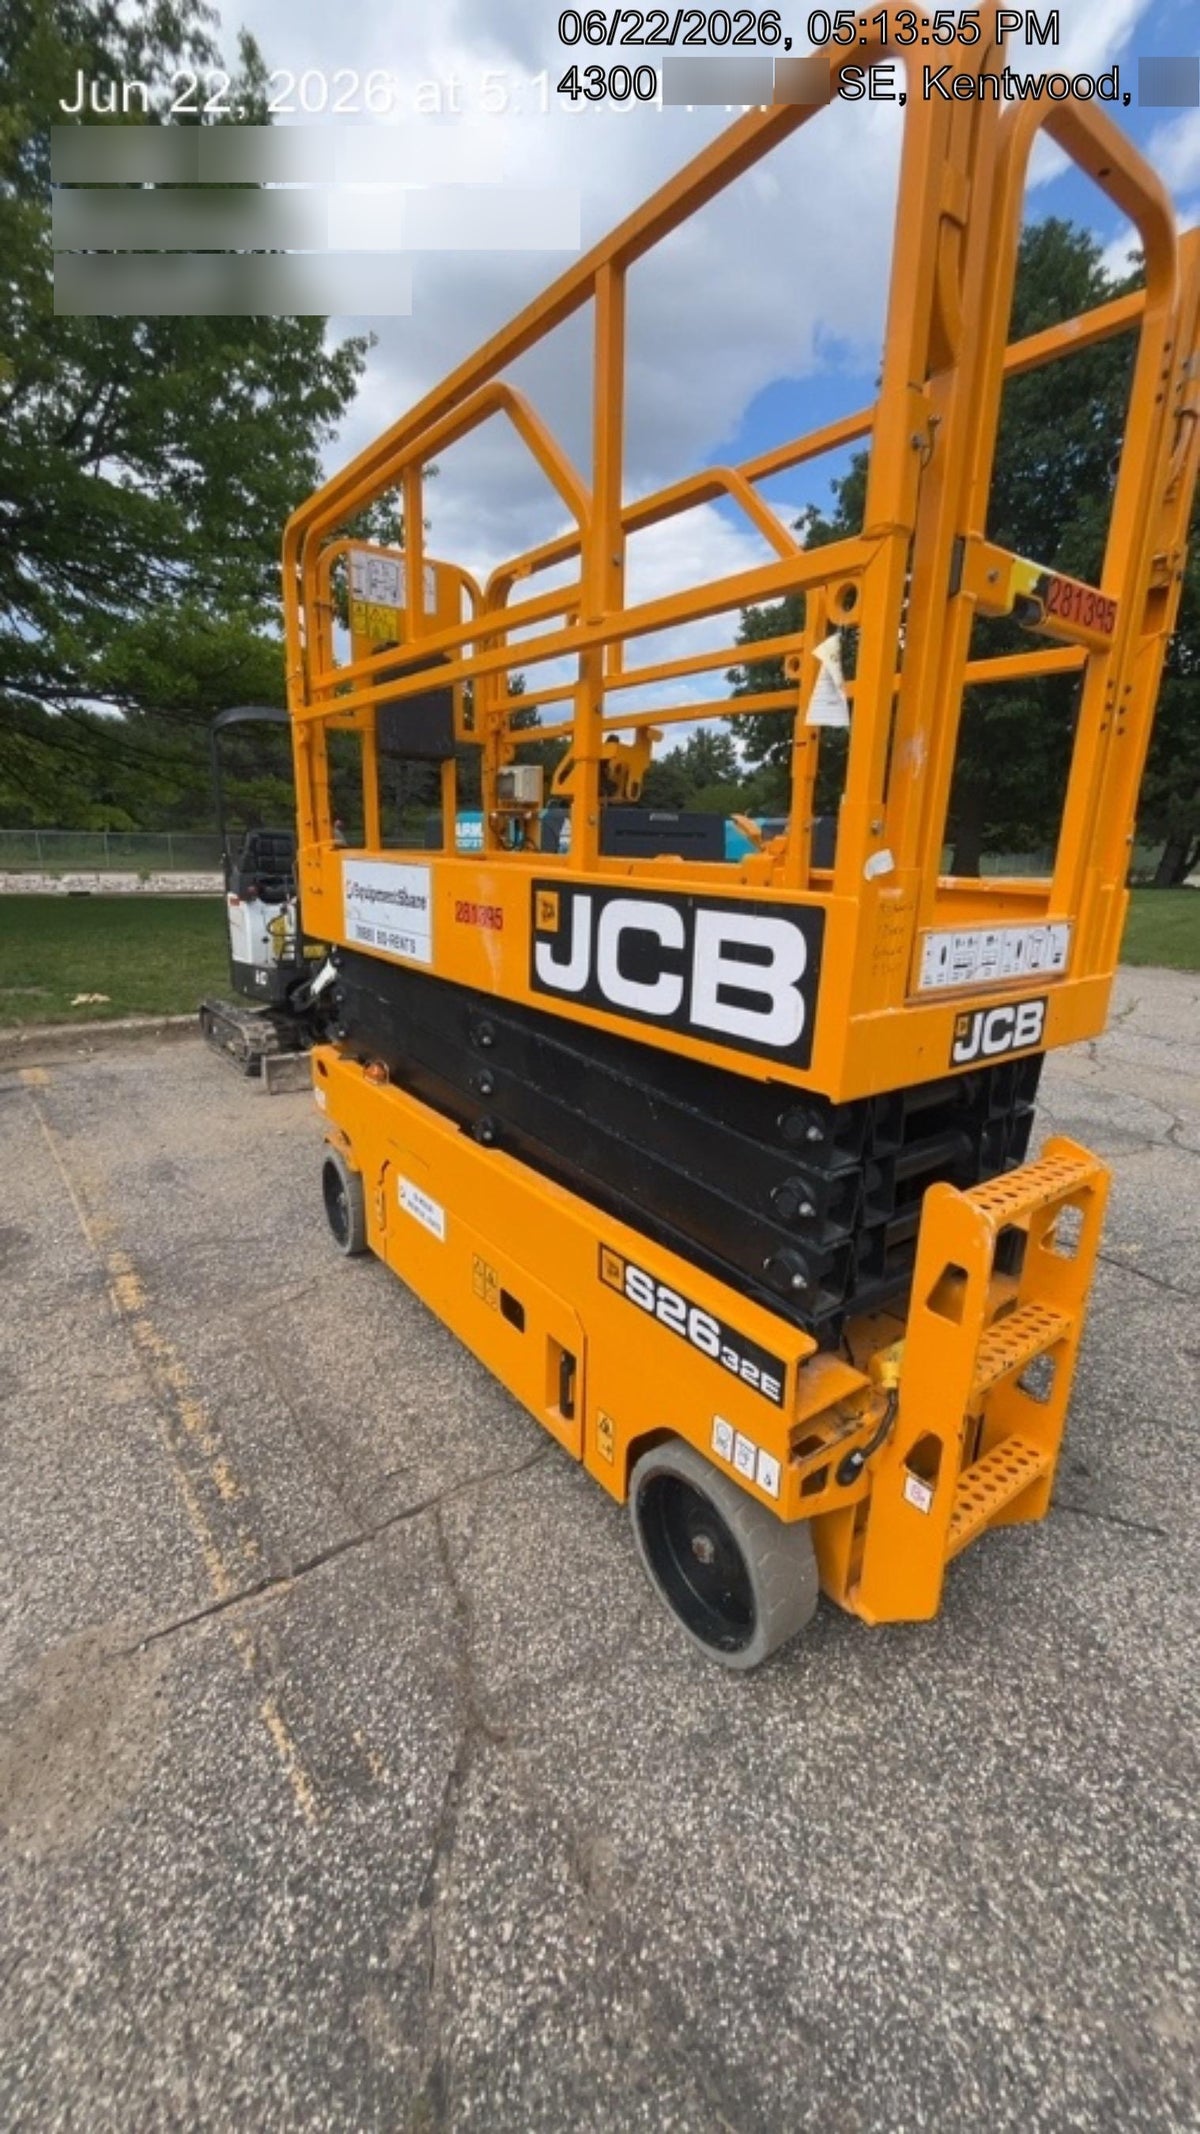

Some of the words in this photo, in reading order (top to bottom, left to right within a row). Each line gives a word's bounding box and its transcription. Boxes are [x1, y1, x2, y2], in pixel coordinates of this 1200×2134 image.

[1048, 577, 1117, 635] 281395
[535, 893, 808, 1048] JCB
[952, 1001, 1045, 1063] JCB
